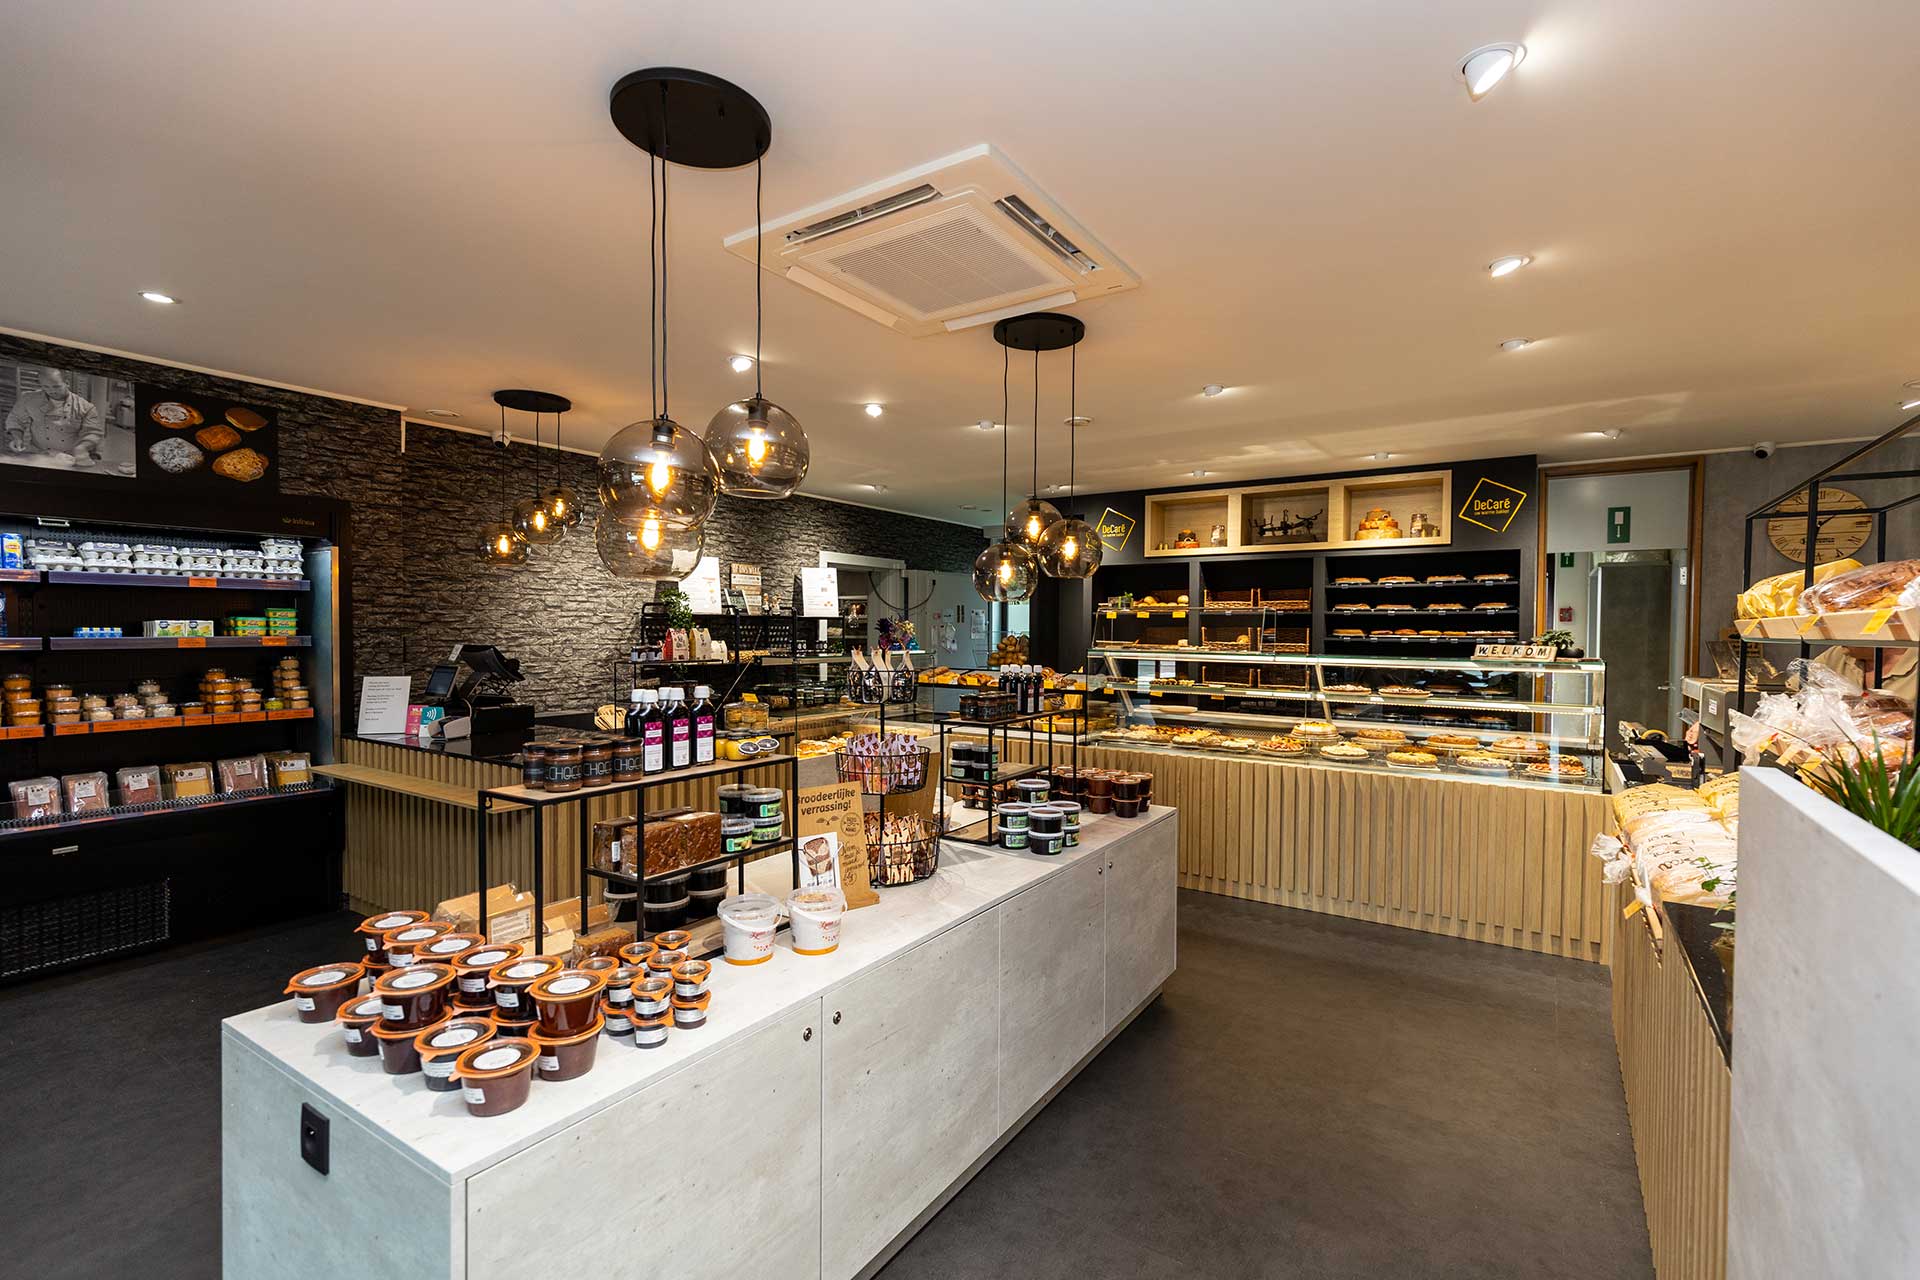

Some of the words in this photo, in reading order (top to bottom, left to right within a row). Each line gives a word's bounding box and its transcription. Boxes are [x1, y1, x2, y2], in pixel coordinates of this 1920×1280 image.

[1474, 498, 1511, 511] DeCaré
[1478, 646, 1548, 656] WELKOM
[801, 800, 852, 816] verrassing!
